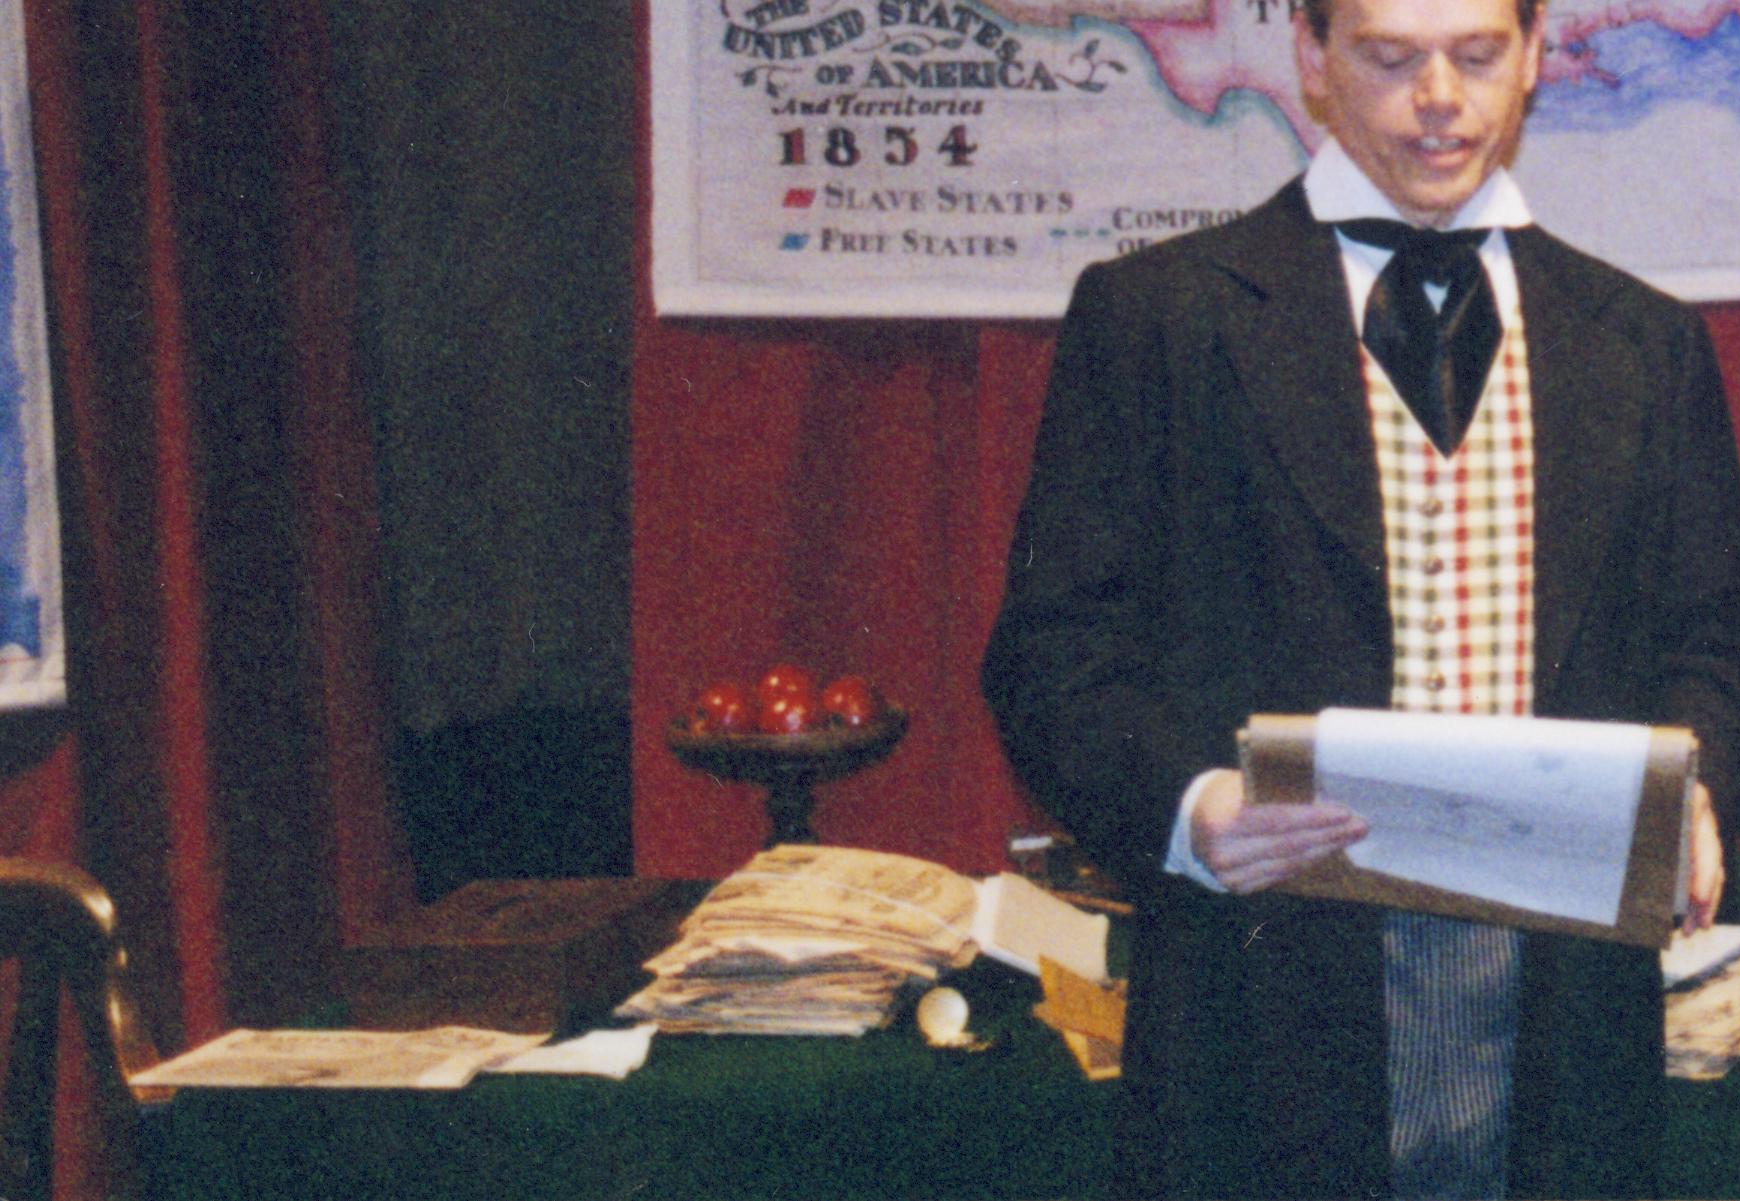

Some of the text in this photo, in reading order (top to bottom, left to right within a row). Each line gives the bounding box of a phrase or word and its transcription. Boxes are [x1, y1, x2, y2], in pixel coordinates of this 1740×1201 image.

[723, 9, 867, 60] UNITED
[865, 55, 1060, 92] AMERICA
[770, 95, 985, 117] And Territories
[777, 124, 978, 167] 1854
[822, 185, 1074, 214] SLAVE STATES
[906, 229, 1018, 255] STATES
